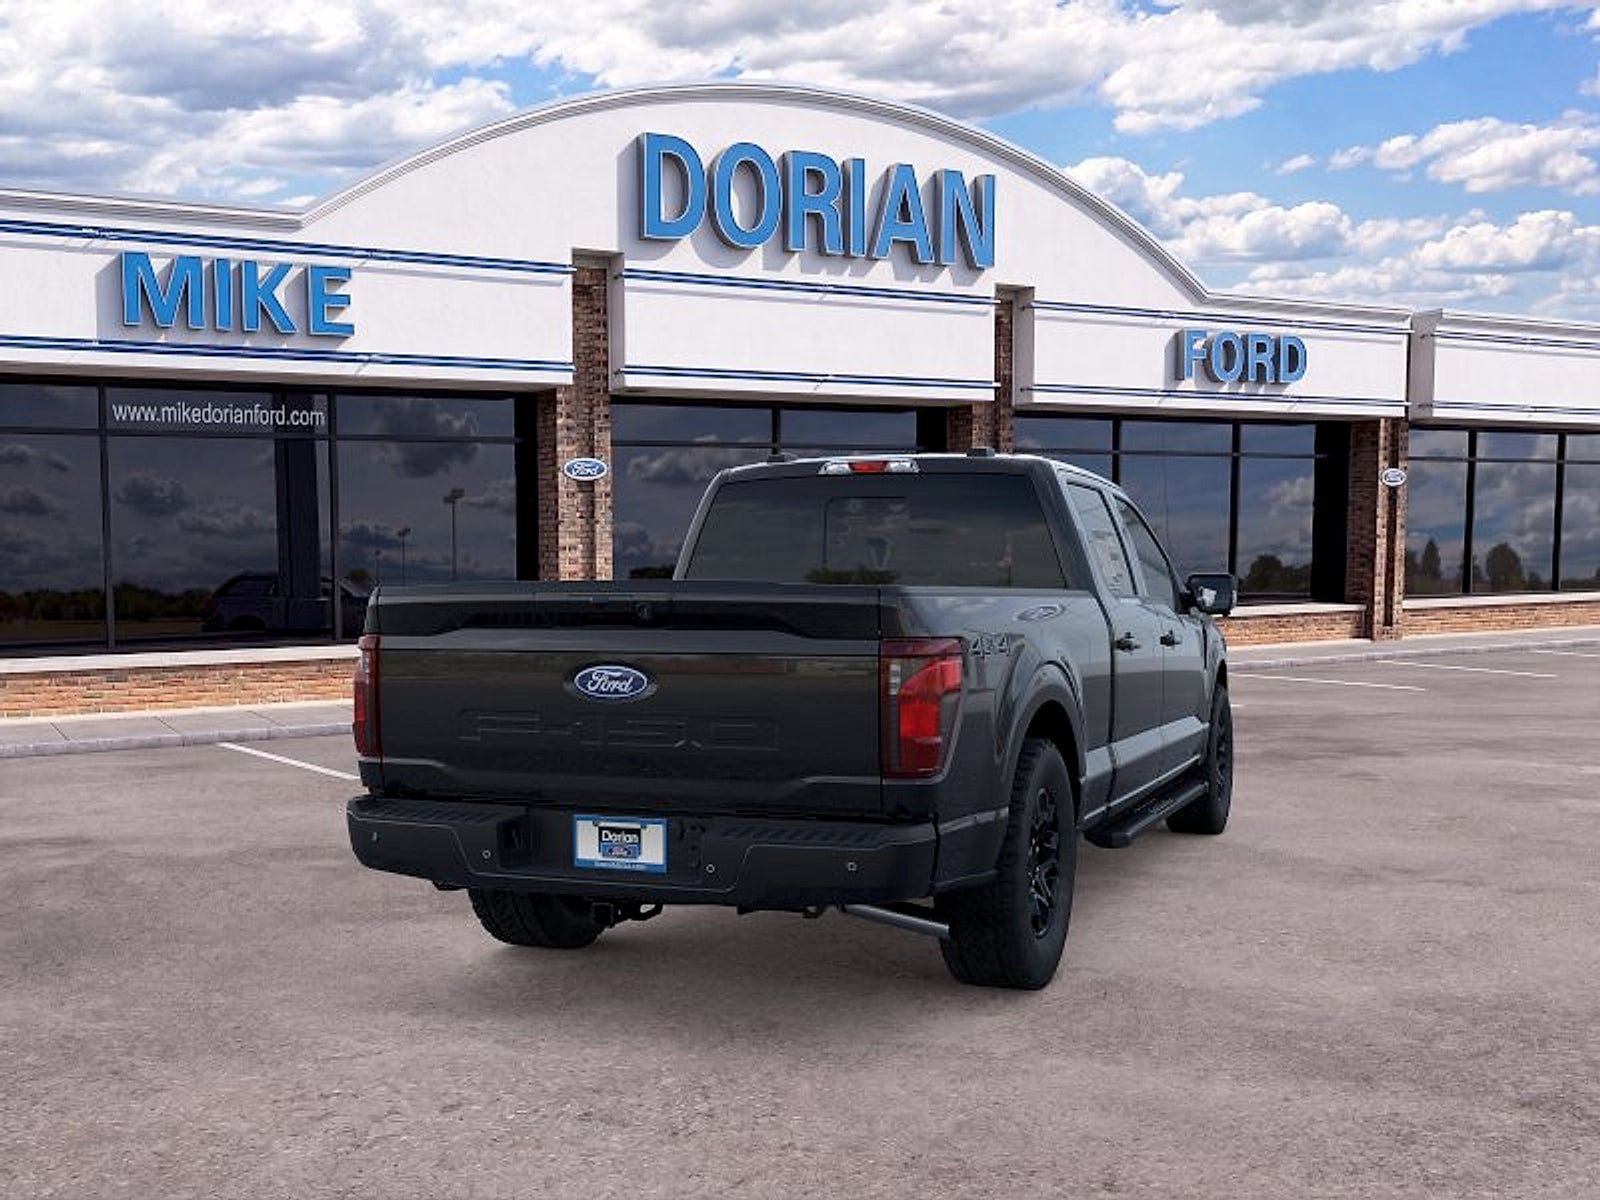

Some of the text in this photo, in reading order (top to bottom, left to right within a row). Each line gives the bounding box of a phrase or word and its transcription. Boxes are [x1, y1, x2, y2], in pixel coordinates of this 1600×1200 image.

[639, 132, 996, 269] DORIAN
[120, 251, 355, 337] MIKE
[1177, 328, 1308, 384] FORD
[112, 401, 326, 426] www.mikedorianford.com
[571, 461, 601, 476] Ford
[586, 669, 635, 695] Ford
[601, 829, 640, 843] Dorian
